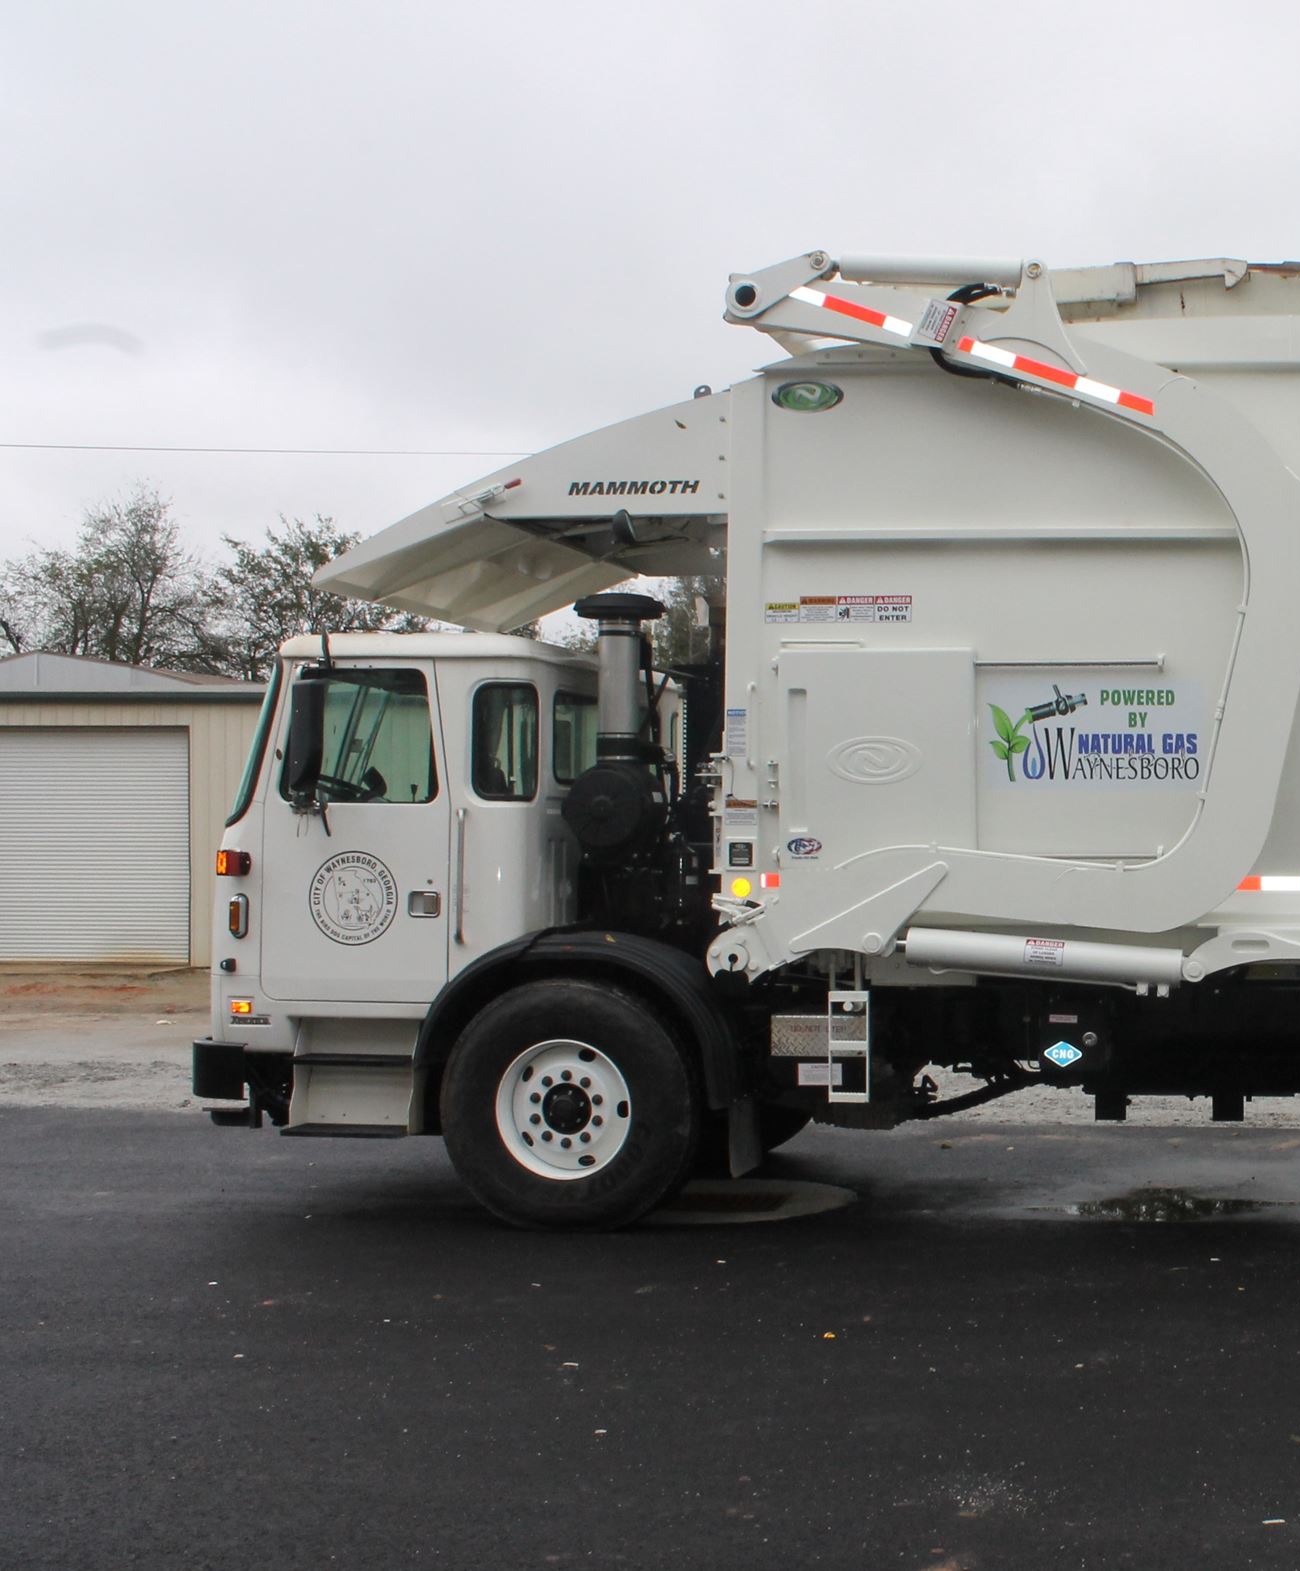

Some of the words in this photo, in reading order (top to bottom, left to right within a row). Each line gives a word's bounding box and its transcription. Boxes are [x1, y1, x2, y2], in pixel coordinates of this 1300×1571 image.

[568, 480, 700, 496] MAMMOTH
[847, 596, 874, 604] DANGER
[884, 596, 912, 604] DANGER
[1100, 689, 1175, 706] POWERED
[1128, 711, 1148, 728] BY
[1078, 733, 1155, 755] NATURAL
[1162, 733, 1198, 755] GAS
[313, 887, 321, 906] CITY
[317, 874, 326, 885] OF
[324, 855, 377, 874] WAYNESBORO,
[378, 869, 394, 906] GEORGIA
[1052, 1049, 1074, 1059] CNG
